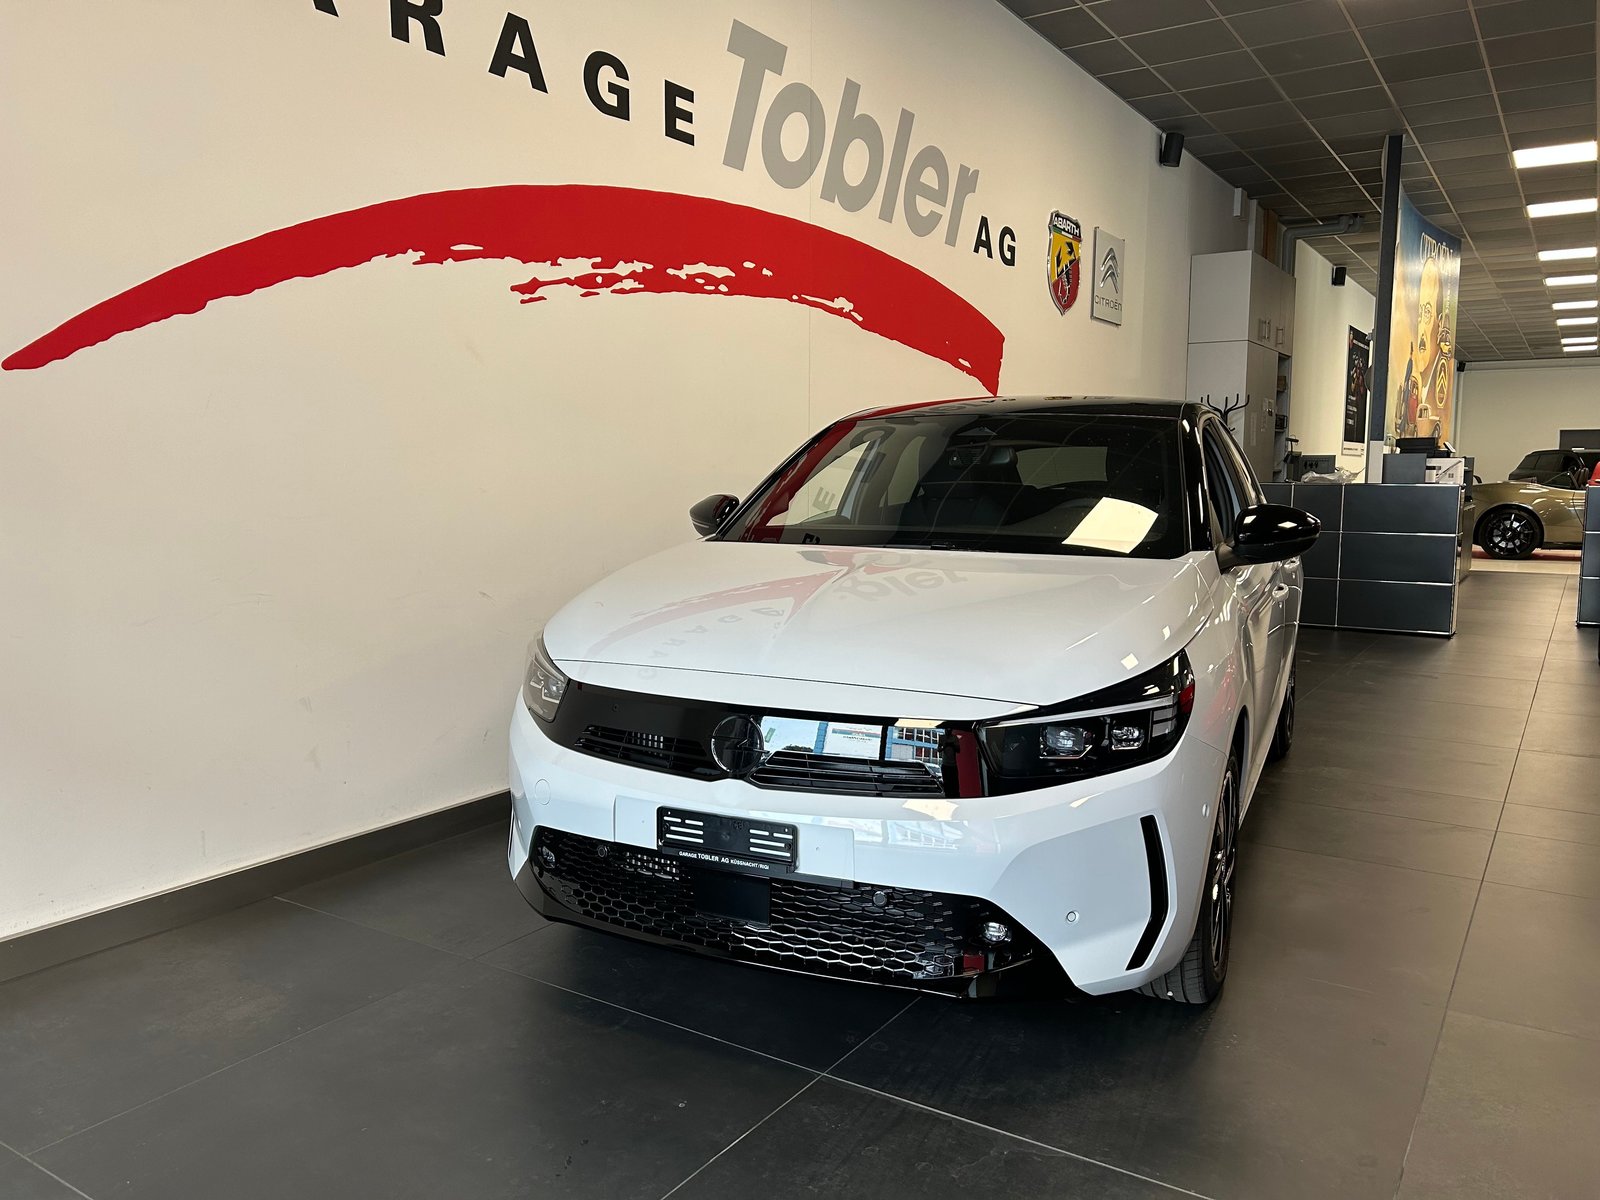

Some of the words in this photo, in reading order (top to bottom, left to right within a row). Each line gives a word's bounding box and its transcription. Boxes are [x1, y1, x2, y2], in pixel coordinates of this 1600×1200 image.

[312, 0, 695, 147] RAGE
[722, 18, 980, 248] Tobler
[973, 215, 1016, 267] AG
[1053, 215, 1080, 237] ABARTH
[1094, 294, 1122, 312] CITROËN
[679, 851, 697, 859] GARAGE
[698, 853, 719, 862] TOBLER
